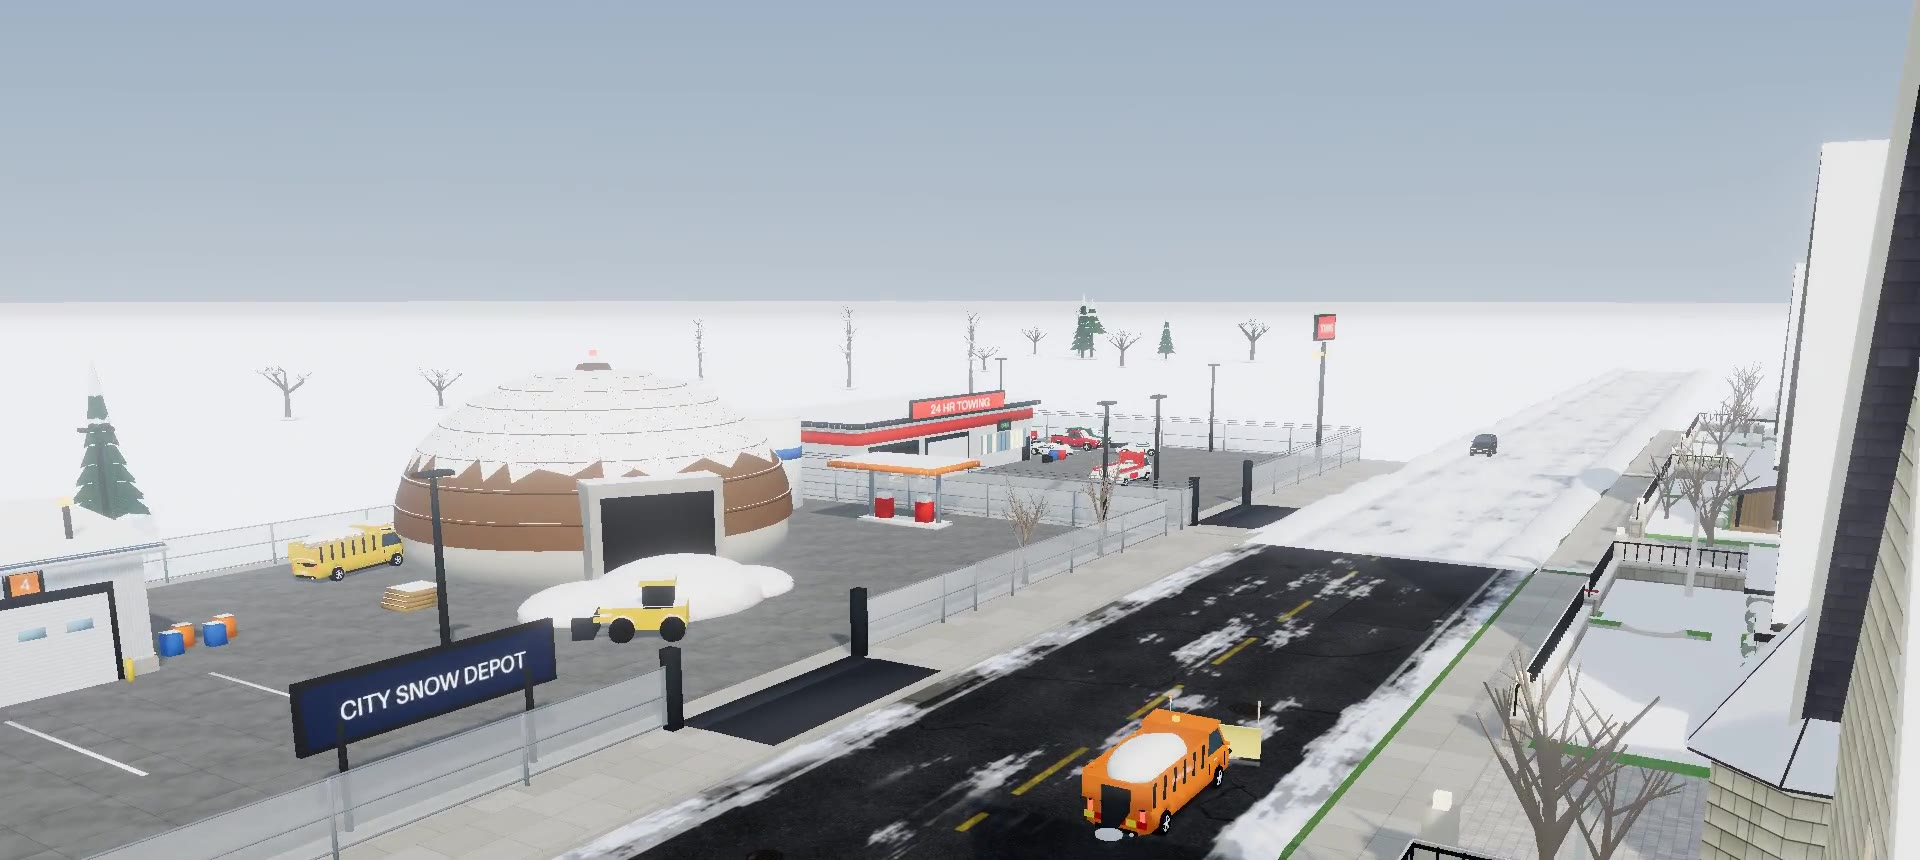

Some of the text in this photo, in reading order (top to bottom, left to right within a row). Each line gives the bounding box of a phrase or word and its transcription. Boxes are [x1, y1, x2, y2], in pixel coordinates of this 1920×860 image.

[931, 398, 990, 414] 24 HR TOWING
[20, 578, 30, 590] 4
[340, 651, 526, 720] CITY SNOW DEPOT
